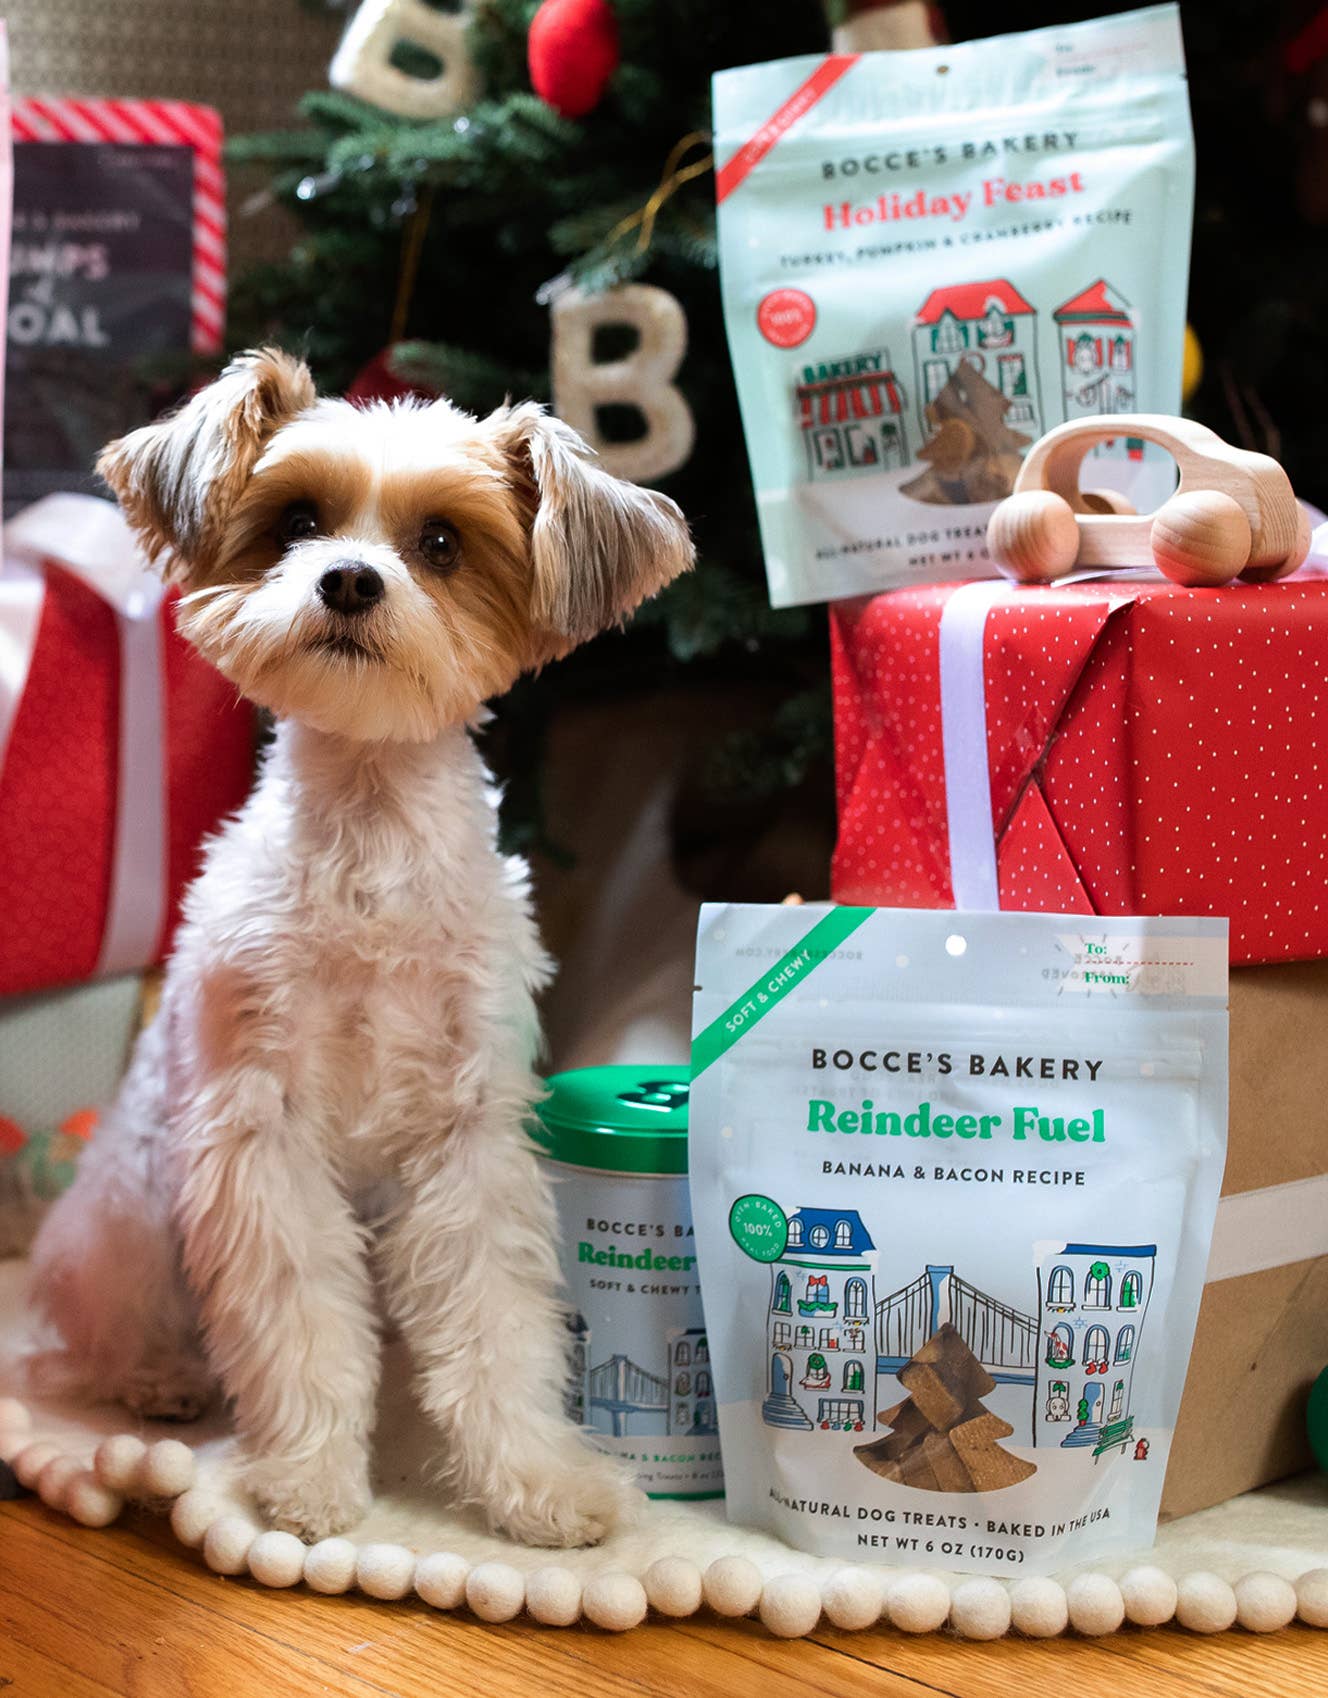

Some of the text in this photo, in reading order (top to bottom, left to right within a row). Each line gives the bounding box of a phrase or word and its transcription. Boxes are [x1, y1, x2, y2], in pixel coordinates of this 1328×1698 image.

[822, 132, 1078, 180] BOCCE'S BAKERY
[823, 171, 1086, 231] Holiday Feast
[1085, 943, 1107, 955] To:
[725, 949, 812, 1033] SOFT & CHEWY
[1084, 971, 1130, 985] From:
[812, 1048, 1103, 1081] BOCCE'S BAKERY
[806, 1099, 1106, 1143] Reindeer Fuel
[822, 1160, 1085, 1185] BANANA & BACON RECIPE
[587, 1218, 665, 1238] BOCCE'S
[743, 1222, 773, 1237] 100%
[578, 1242, 697, 1271] Reindeer
[590, 1279, 622, 1292] SOFT
[627, 1284, 636, 1293] &
[640, 1284, 690, 1295] CHEWY
[857, 1507, 896, 1523] DOG
[903, 1511, 967, 1530] TREATS
[987, 1520, 1045, 1538] BAKED
[1051, 1523, 1066, 1537] IN
[1069, 1514, 1088, 1532] THE
[1090, 1507, 1110, 1523] USA
[857, 1533, 1025, 1564] NET WT 6 OZ (170G)
